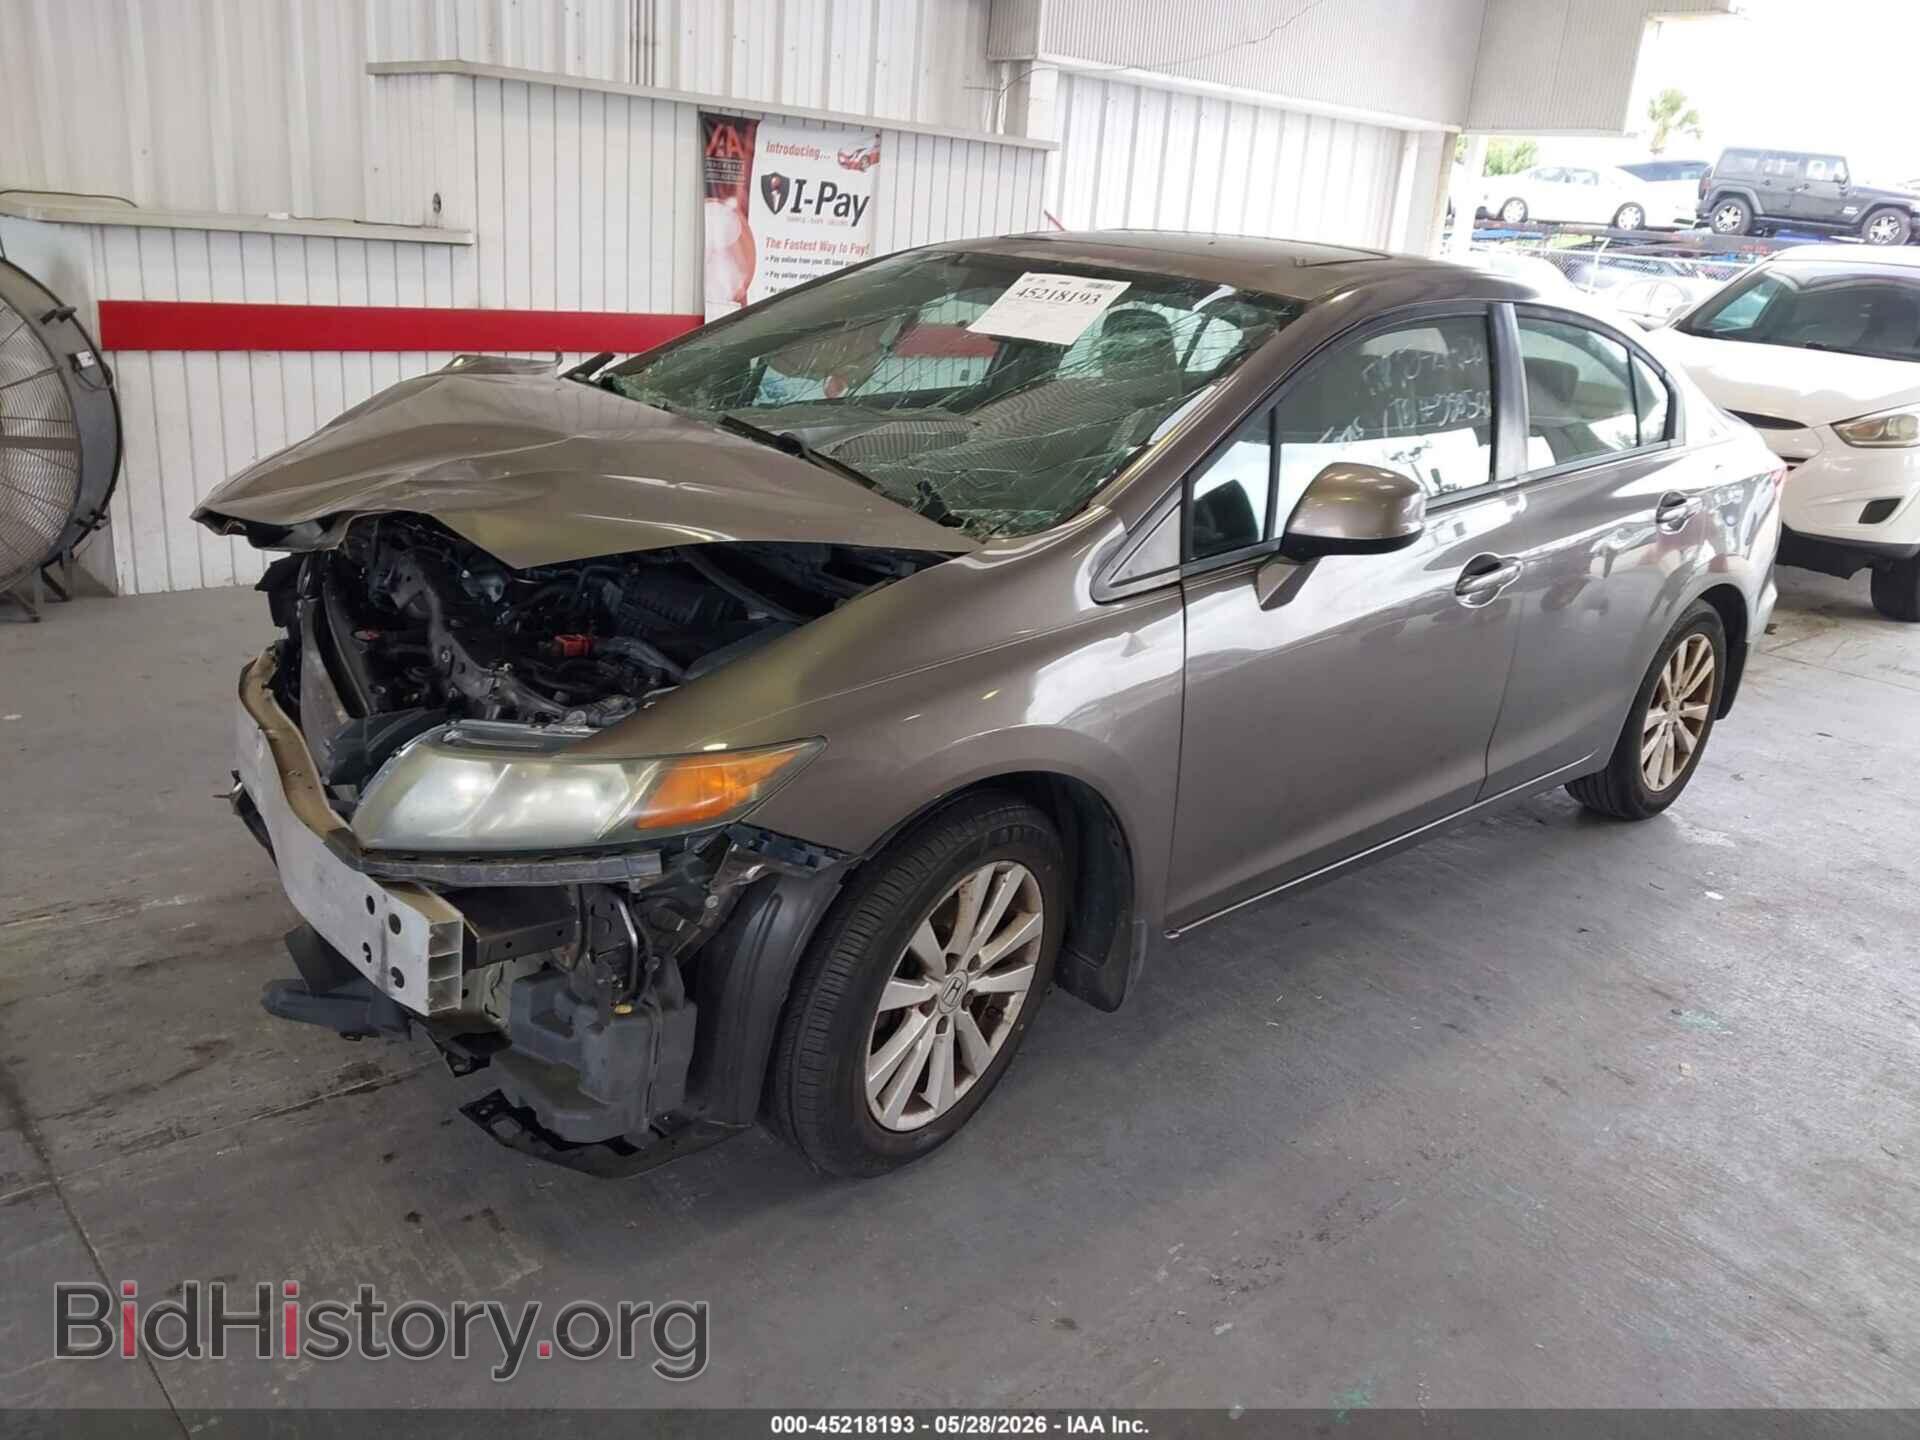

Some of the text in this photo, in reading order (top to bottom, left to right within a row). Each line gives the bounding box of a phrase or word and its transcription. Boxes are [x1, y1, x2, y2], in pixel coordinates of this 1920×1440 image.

[790, 178, 871, 227] I-Pay
[766, 236, 871, 256] The Fastest Way to Pay!
[1016, 287, 1103, 304] 45218193
